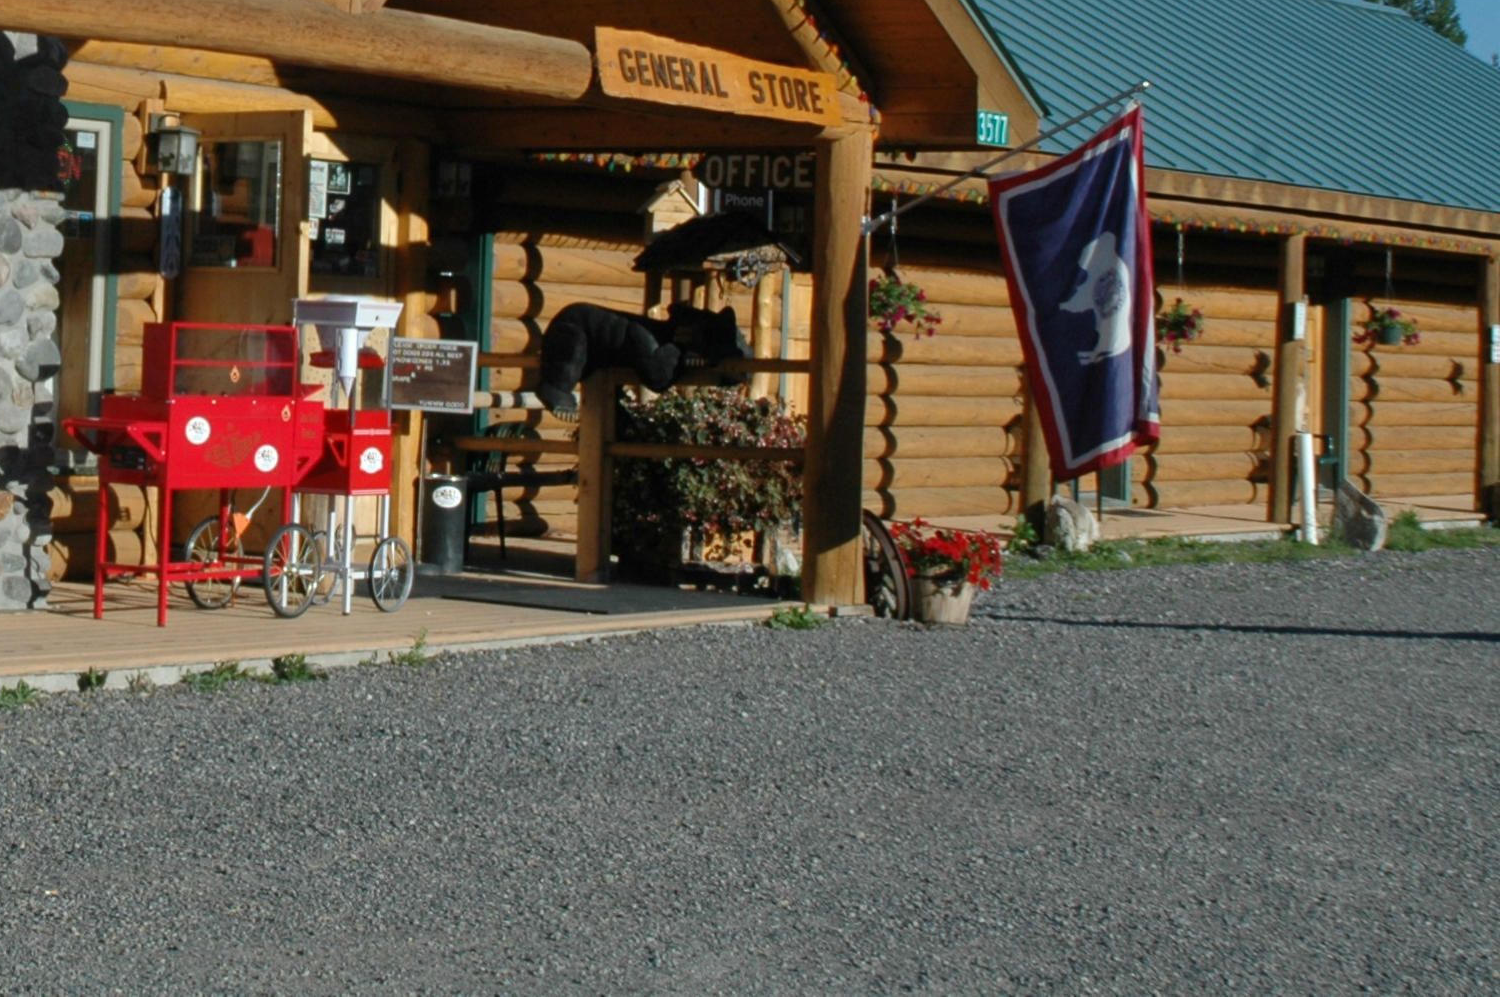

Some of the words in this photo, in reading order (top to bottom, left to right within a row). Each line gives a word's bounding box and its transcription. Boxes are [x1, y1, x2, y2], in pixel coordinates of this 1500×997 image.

[618, 48, 729, 98] GENERAL
[748, 71, 824, 114] STORE
[979, 112, 1008, 144] 3577
[705, 155, 813, 188] OFFICE
[725, 193, 765, 207] Phone
